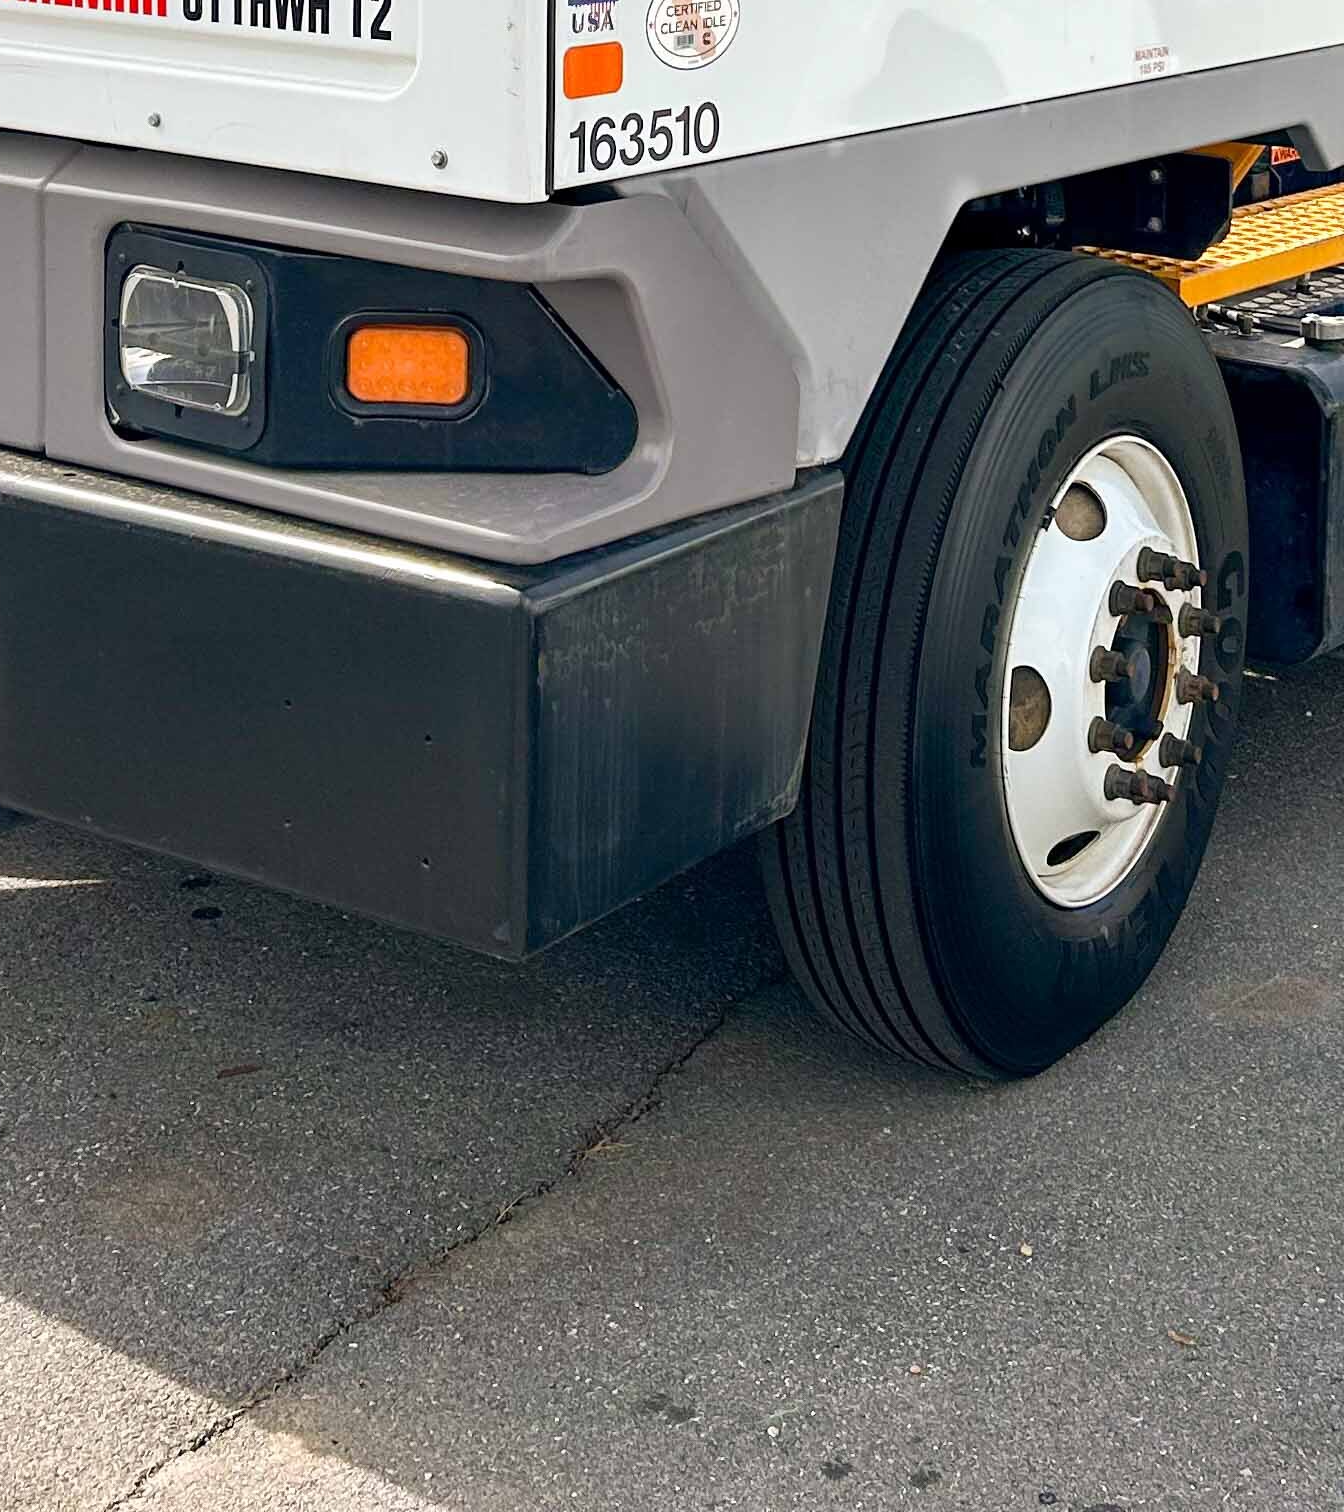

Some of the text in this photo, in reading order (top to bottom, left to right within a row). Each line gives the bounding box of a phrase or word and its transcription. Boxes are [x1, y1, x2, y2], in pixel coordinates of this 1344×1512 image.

[666, 0, 722, 18] CERTIFIED
[572, 11, 614, 33] USA
[660, 15, 727, 35] CLEAN IDLE
[569, 101, 720, 174] 163510
